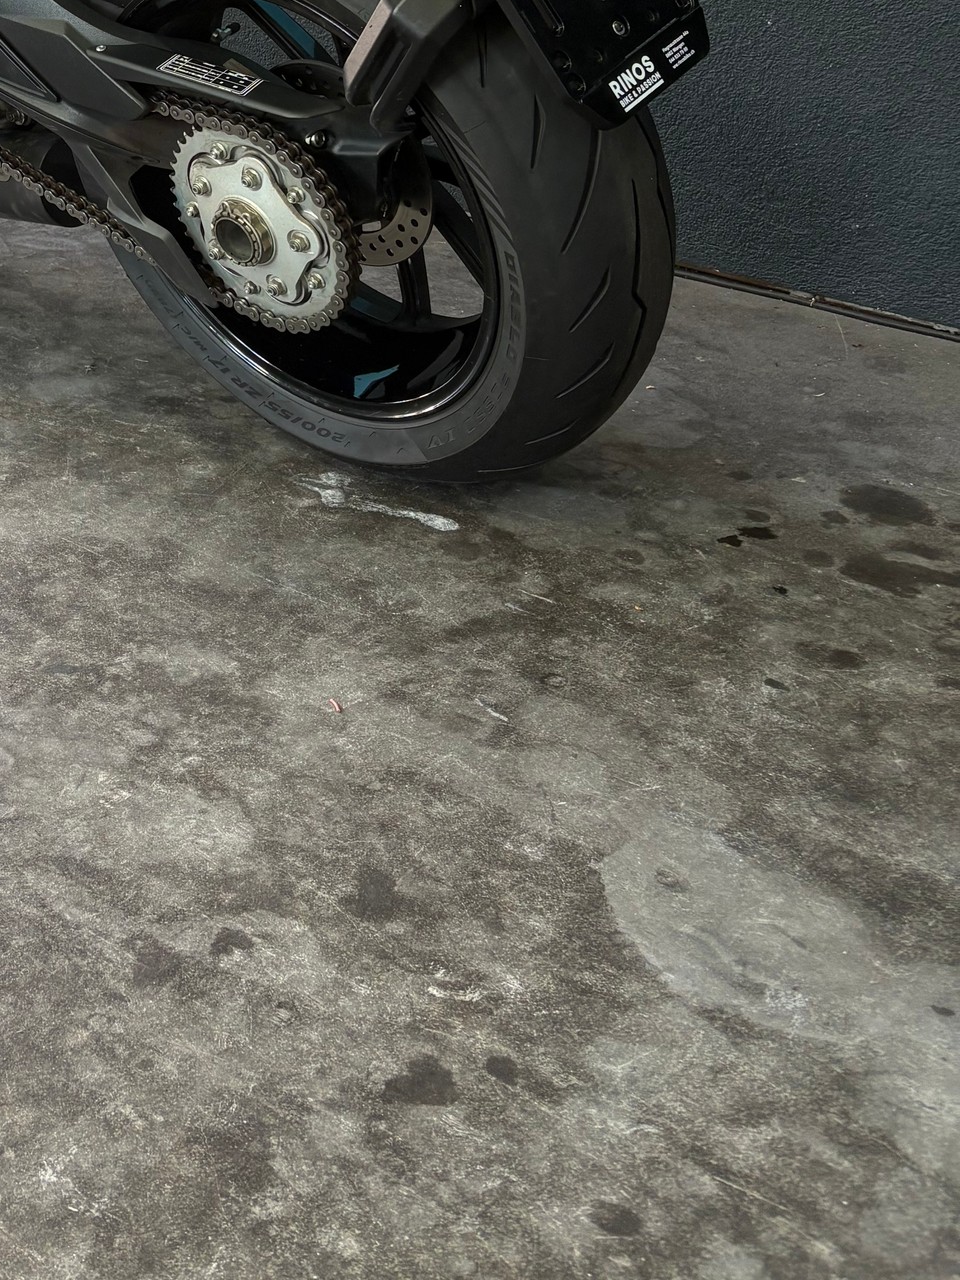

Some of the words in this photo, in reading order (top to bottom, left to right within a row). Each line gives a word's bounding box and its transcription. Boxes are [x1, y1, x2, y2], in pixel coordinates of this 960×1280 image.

[608, 55, 655, 99] RINOS
[619, 93, 635, 108] BIKE
[632, 90, 638, 98] &
[636, 71, 662, 95] PASSION
[230, 375, 263, 400] ZR
[264, 400, 346, 443] 200/55
